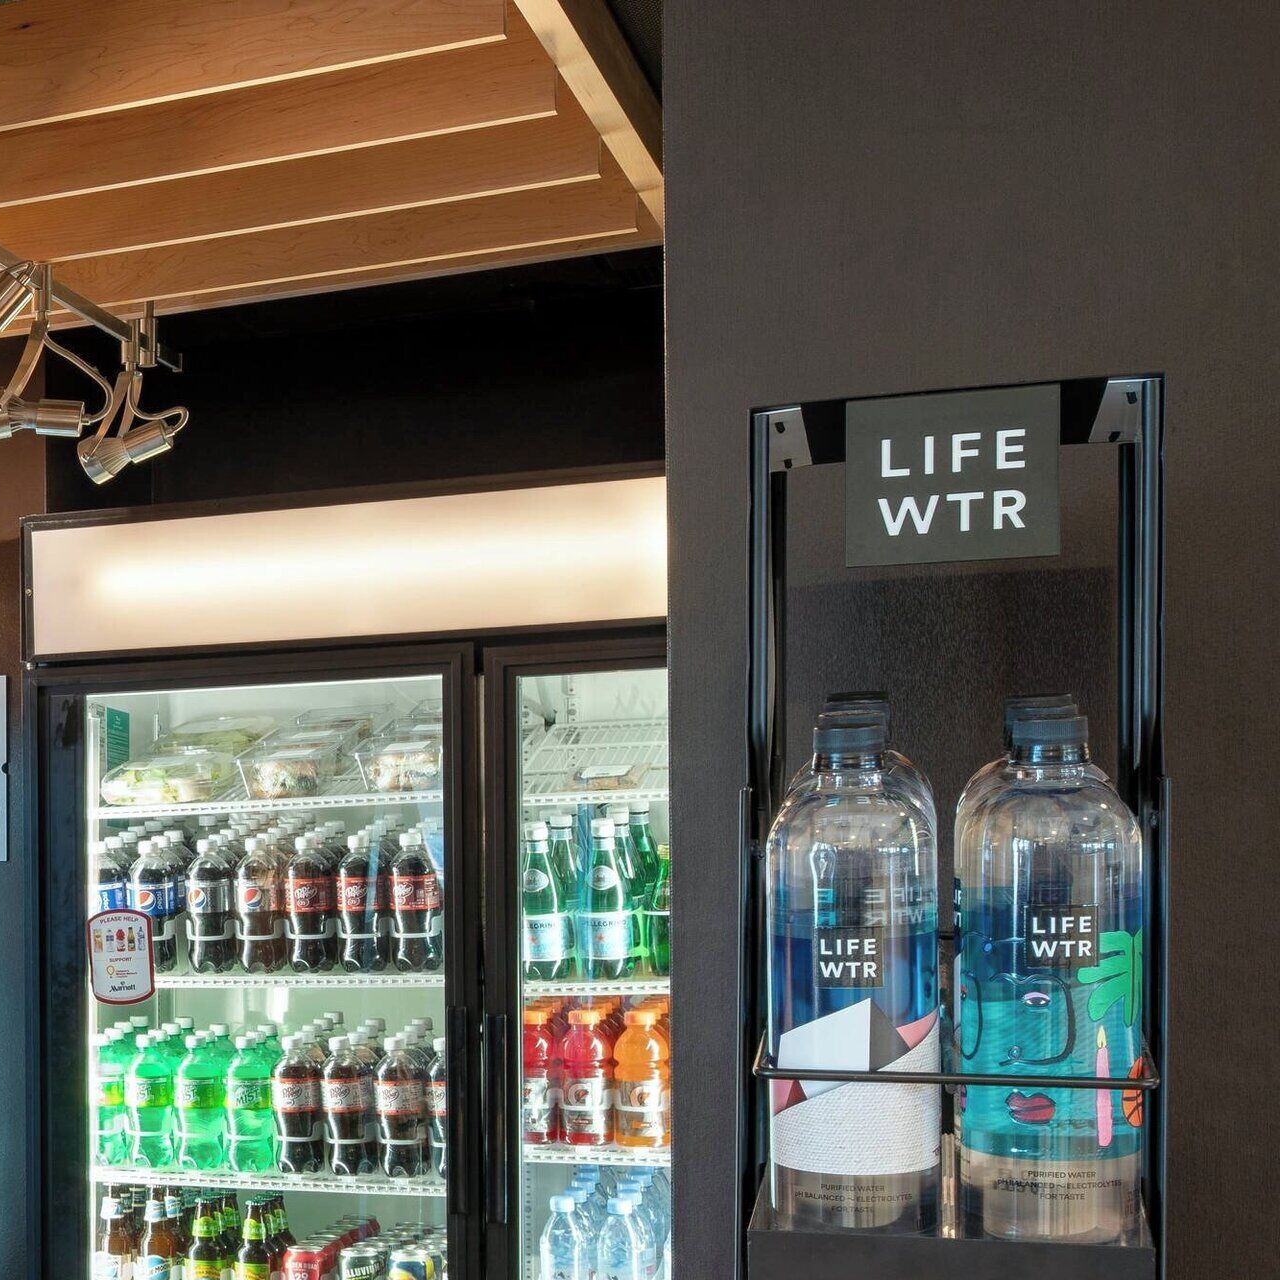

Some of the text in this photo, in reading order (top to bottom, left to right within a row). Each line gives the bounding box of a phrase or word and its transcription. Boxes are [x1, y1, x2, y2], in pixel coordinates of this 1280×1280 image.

[880, 428, 1026, 478] LIFE
[878, 489, 1027, 537] WTR
[99, 915, 139, 925] PLEASE HELP
[1032, 915, 1092, 934] LIFE
[820, 937, 877, 956] LIFE
[1031, 940, 1093, 958] WTR
[820, 962, 878, 979] WTR
[109, 983, 136, 993] Marriott
[1028, 1170, 1097, 1179] PURIFIED WATER
[820, 1183, 885, 1192] PURIFIED WATER
[1005, 1178, 1122, 1189] BALANCED ELECTROLYTES
[804, 1191, 912, 1203] BALANCED ELECTROLYTES
[1040, 1193, 1085, 1201] FOR TASTE
